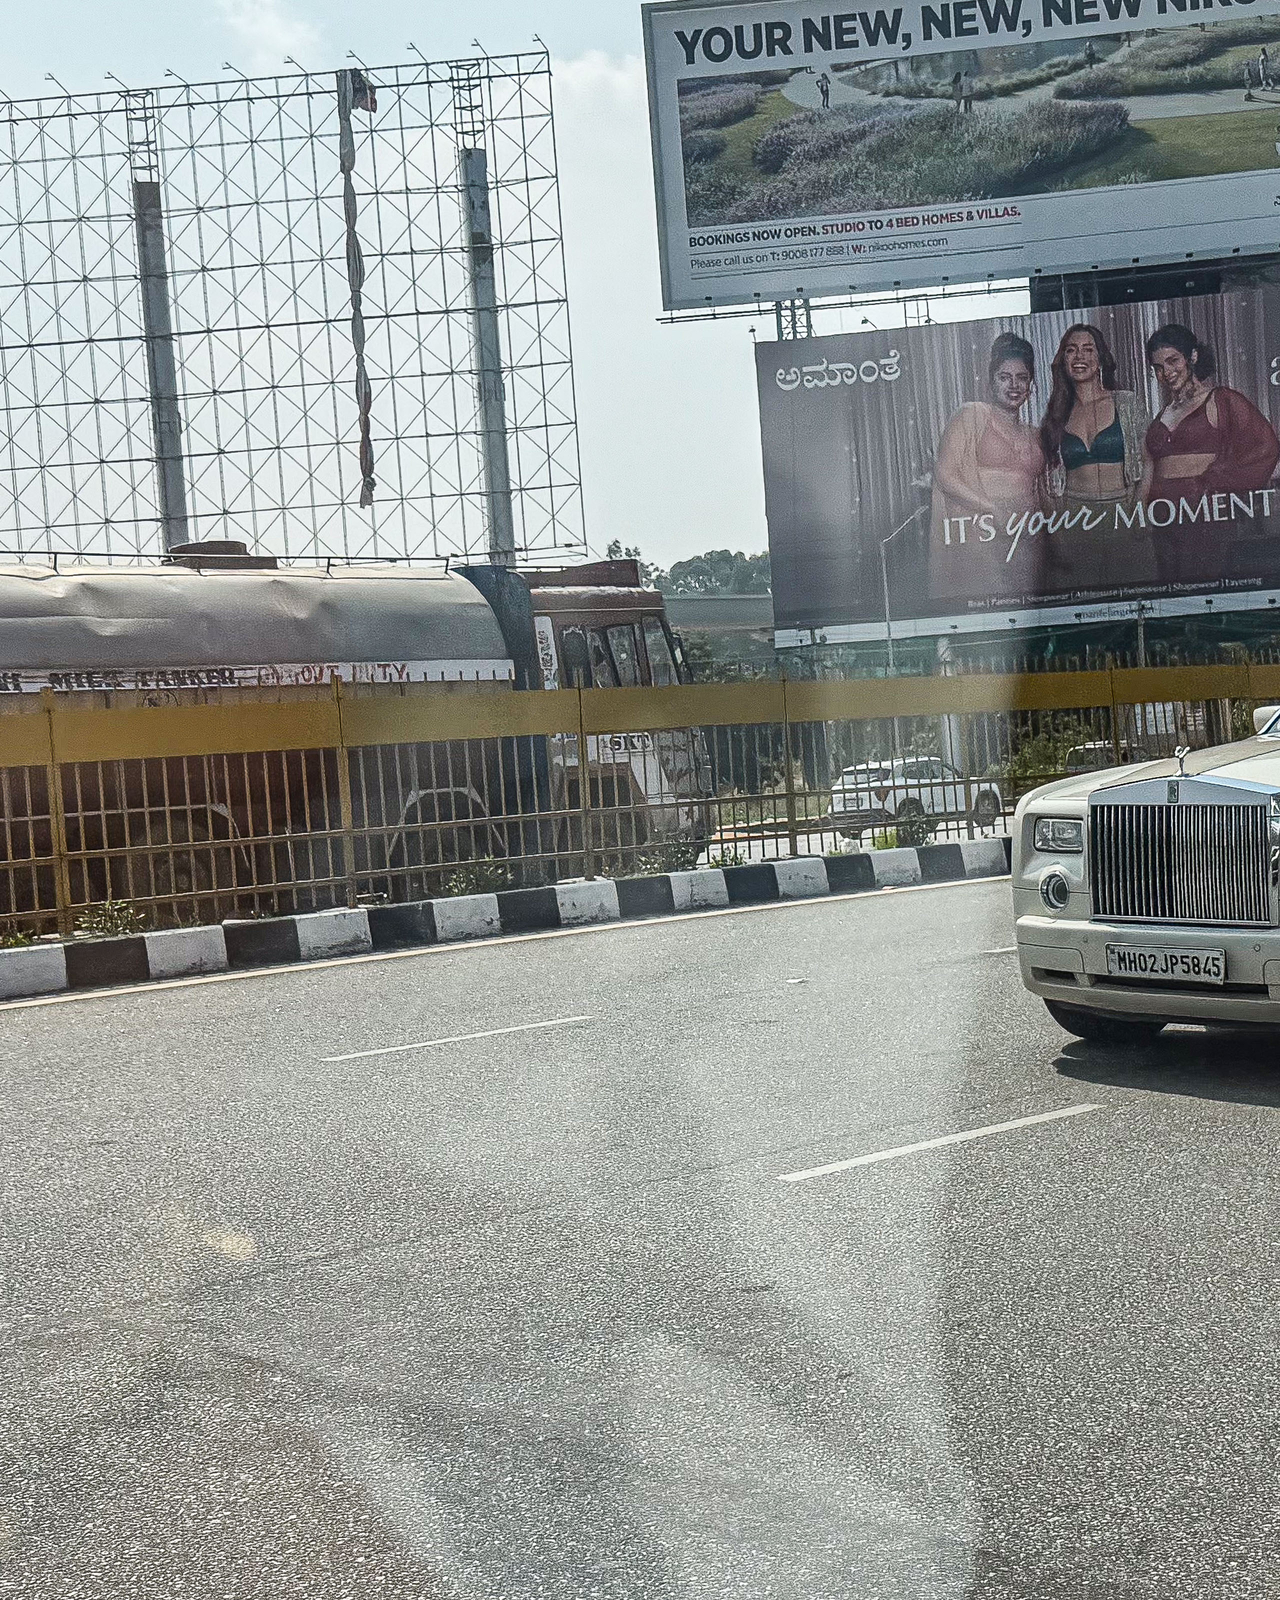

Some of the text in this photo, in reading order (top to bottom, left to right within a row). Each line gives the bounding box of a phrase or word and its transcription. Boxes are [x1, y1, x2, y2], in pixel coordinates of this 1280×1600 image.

[674, 21, 794, 65] YOUR
[802, 8, 912, 51] NEW,
[921, 0, 1031, 38] NEW,
[689, 206, 1022, 248] BOOKINGS NOW OPEN. STUDIO TO 4 BED HOMES & VILLAS.
[690, 257, 722, 269] Please
[724, 254, 740, 266] call
[742, 256, 754, 264] us
[756, 253, 769, 263] on
[776, 349, 901, 391] ಅಮಾಂತೆ
[943, 489, 1276, 563] IT'S your MOMENT
[1117, 951, 1221, 978] MH02JP5845
